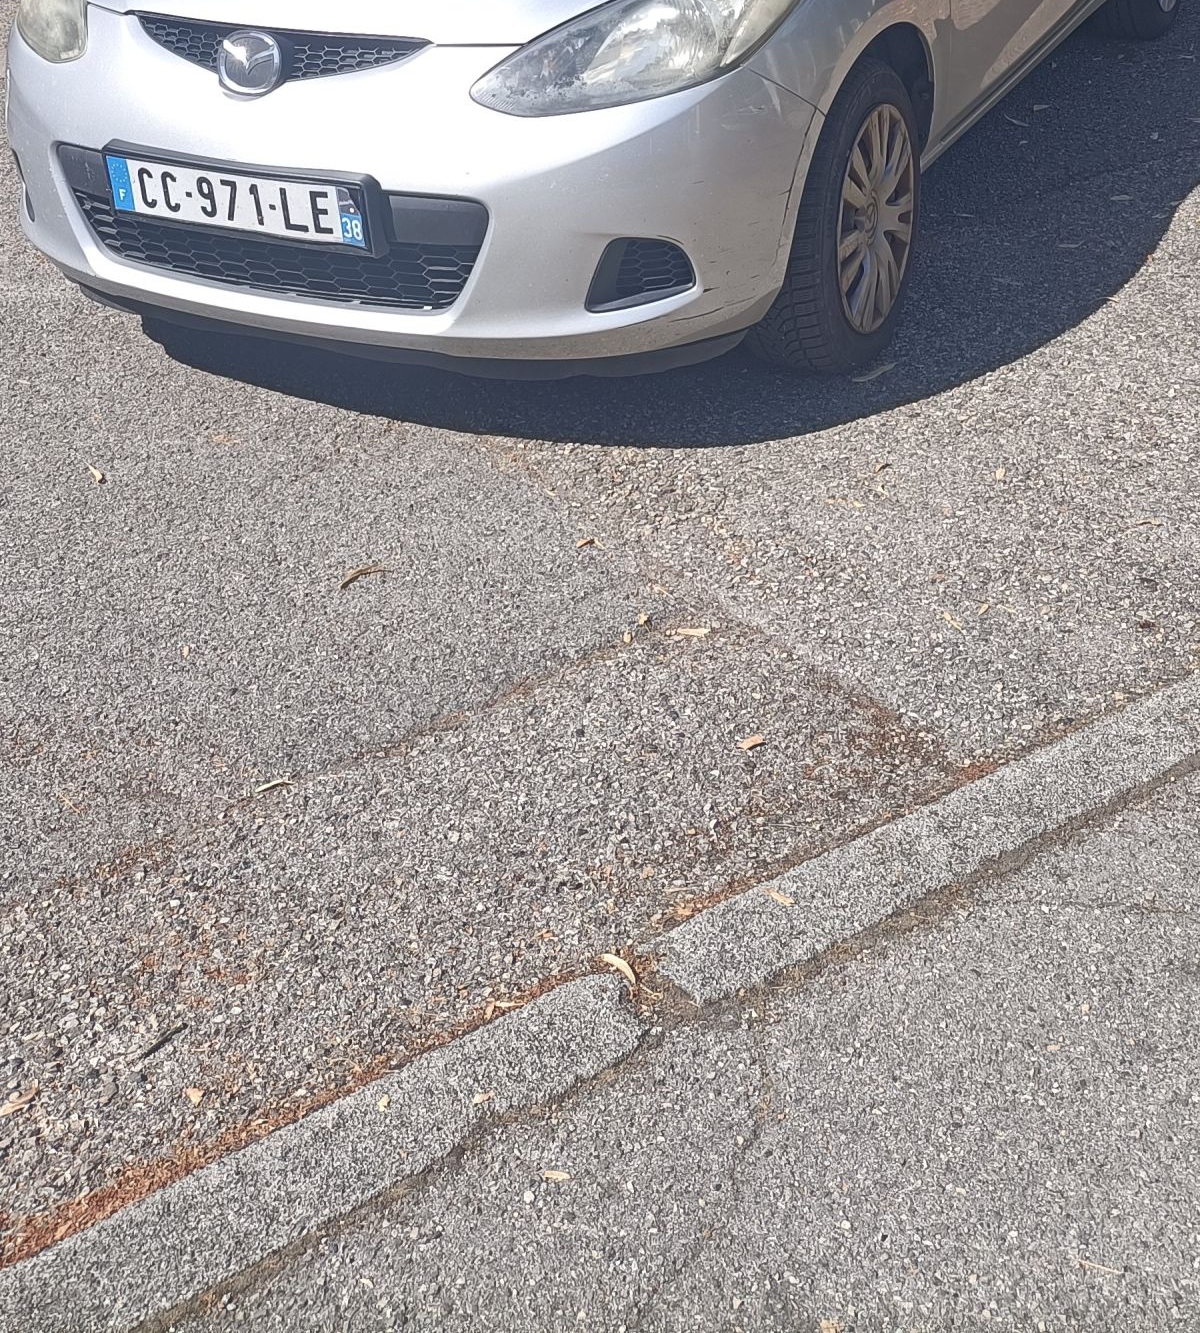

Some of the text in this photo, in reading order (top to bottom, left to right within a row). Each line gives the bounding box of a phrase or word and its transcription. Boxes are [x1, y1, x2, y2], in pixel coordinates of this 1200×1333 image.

[119, 189, 126, 201] F
[137, 167, 334, 234] CC-971-LE
[342, 216, 362, 241] 38
